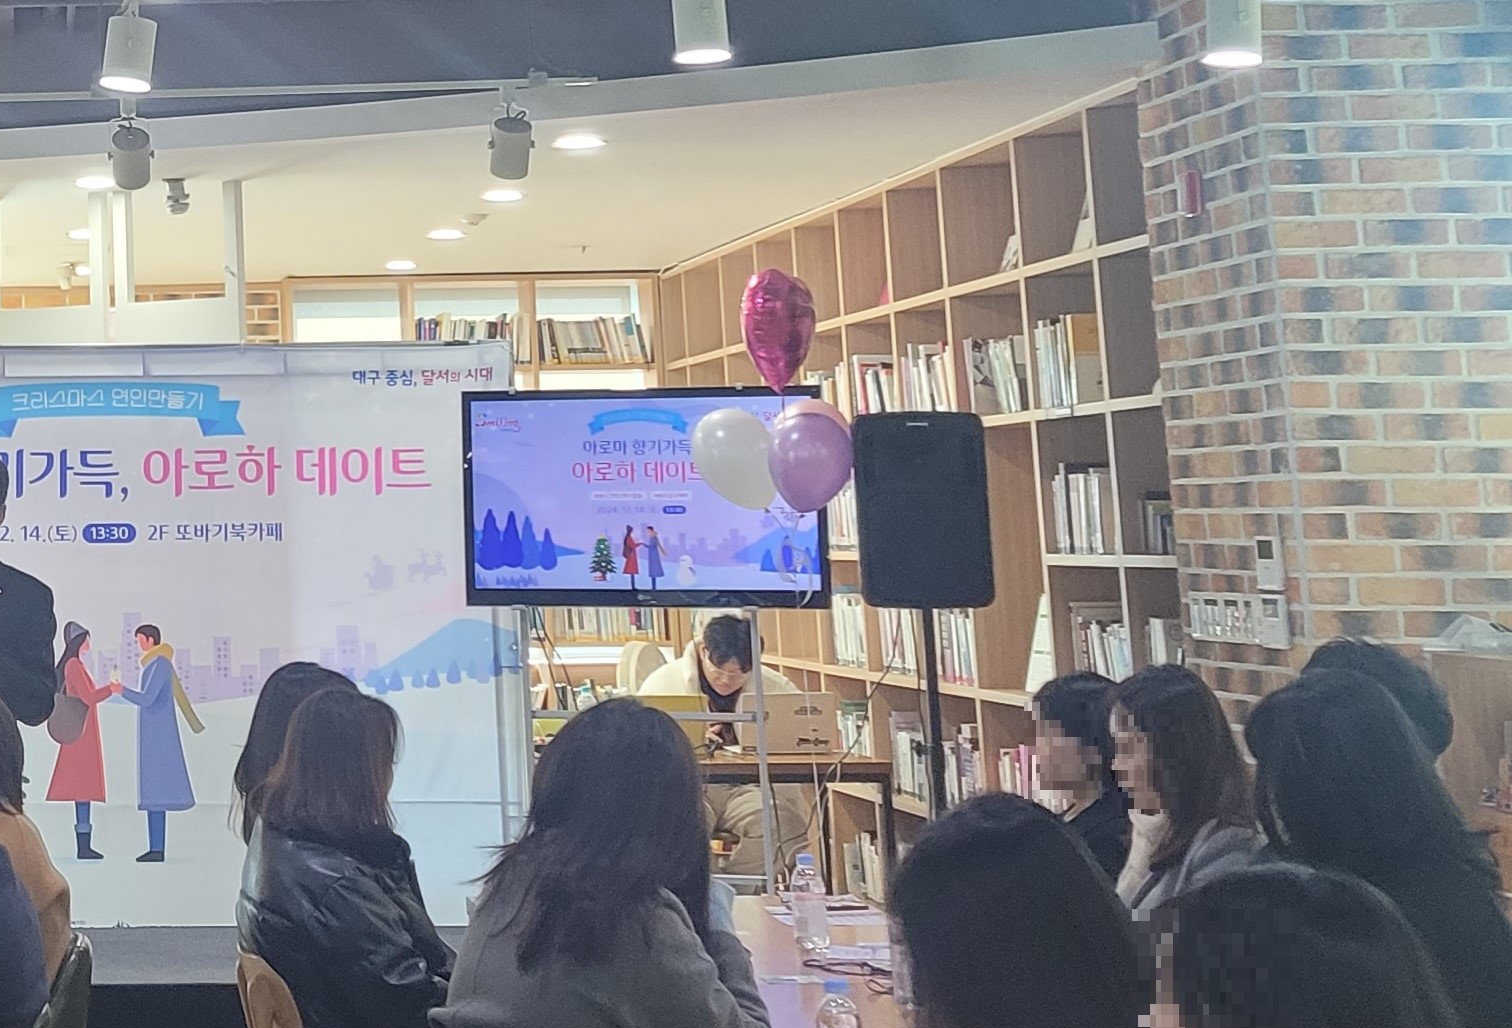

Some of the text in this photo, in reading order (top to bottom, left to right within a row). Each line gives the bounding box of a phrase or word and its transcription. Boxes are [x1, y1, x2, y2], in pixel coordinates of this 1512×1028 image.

[352, 367, 494, 387] 대구 중심, 달서의 시대
[12, 388, 204, 412] 크리스마스 연인만들기
[583, 440, 627, 456] 아로마
[143, 445, 282, 498] 아로하
[296, 446, 432, 497] 데이트
[572, 461, 637, 484] 아로하
[21, 524, 78, 544] 14.(토)
[90, 527, 129, 541] 13:30
[148, 525, 170, 542] 2F
[175, 522, 284, 543] 또바기북카페
